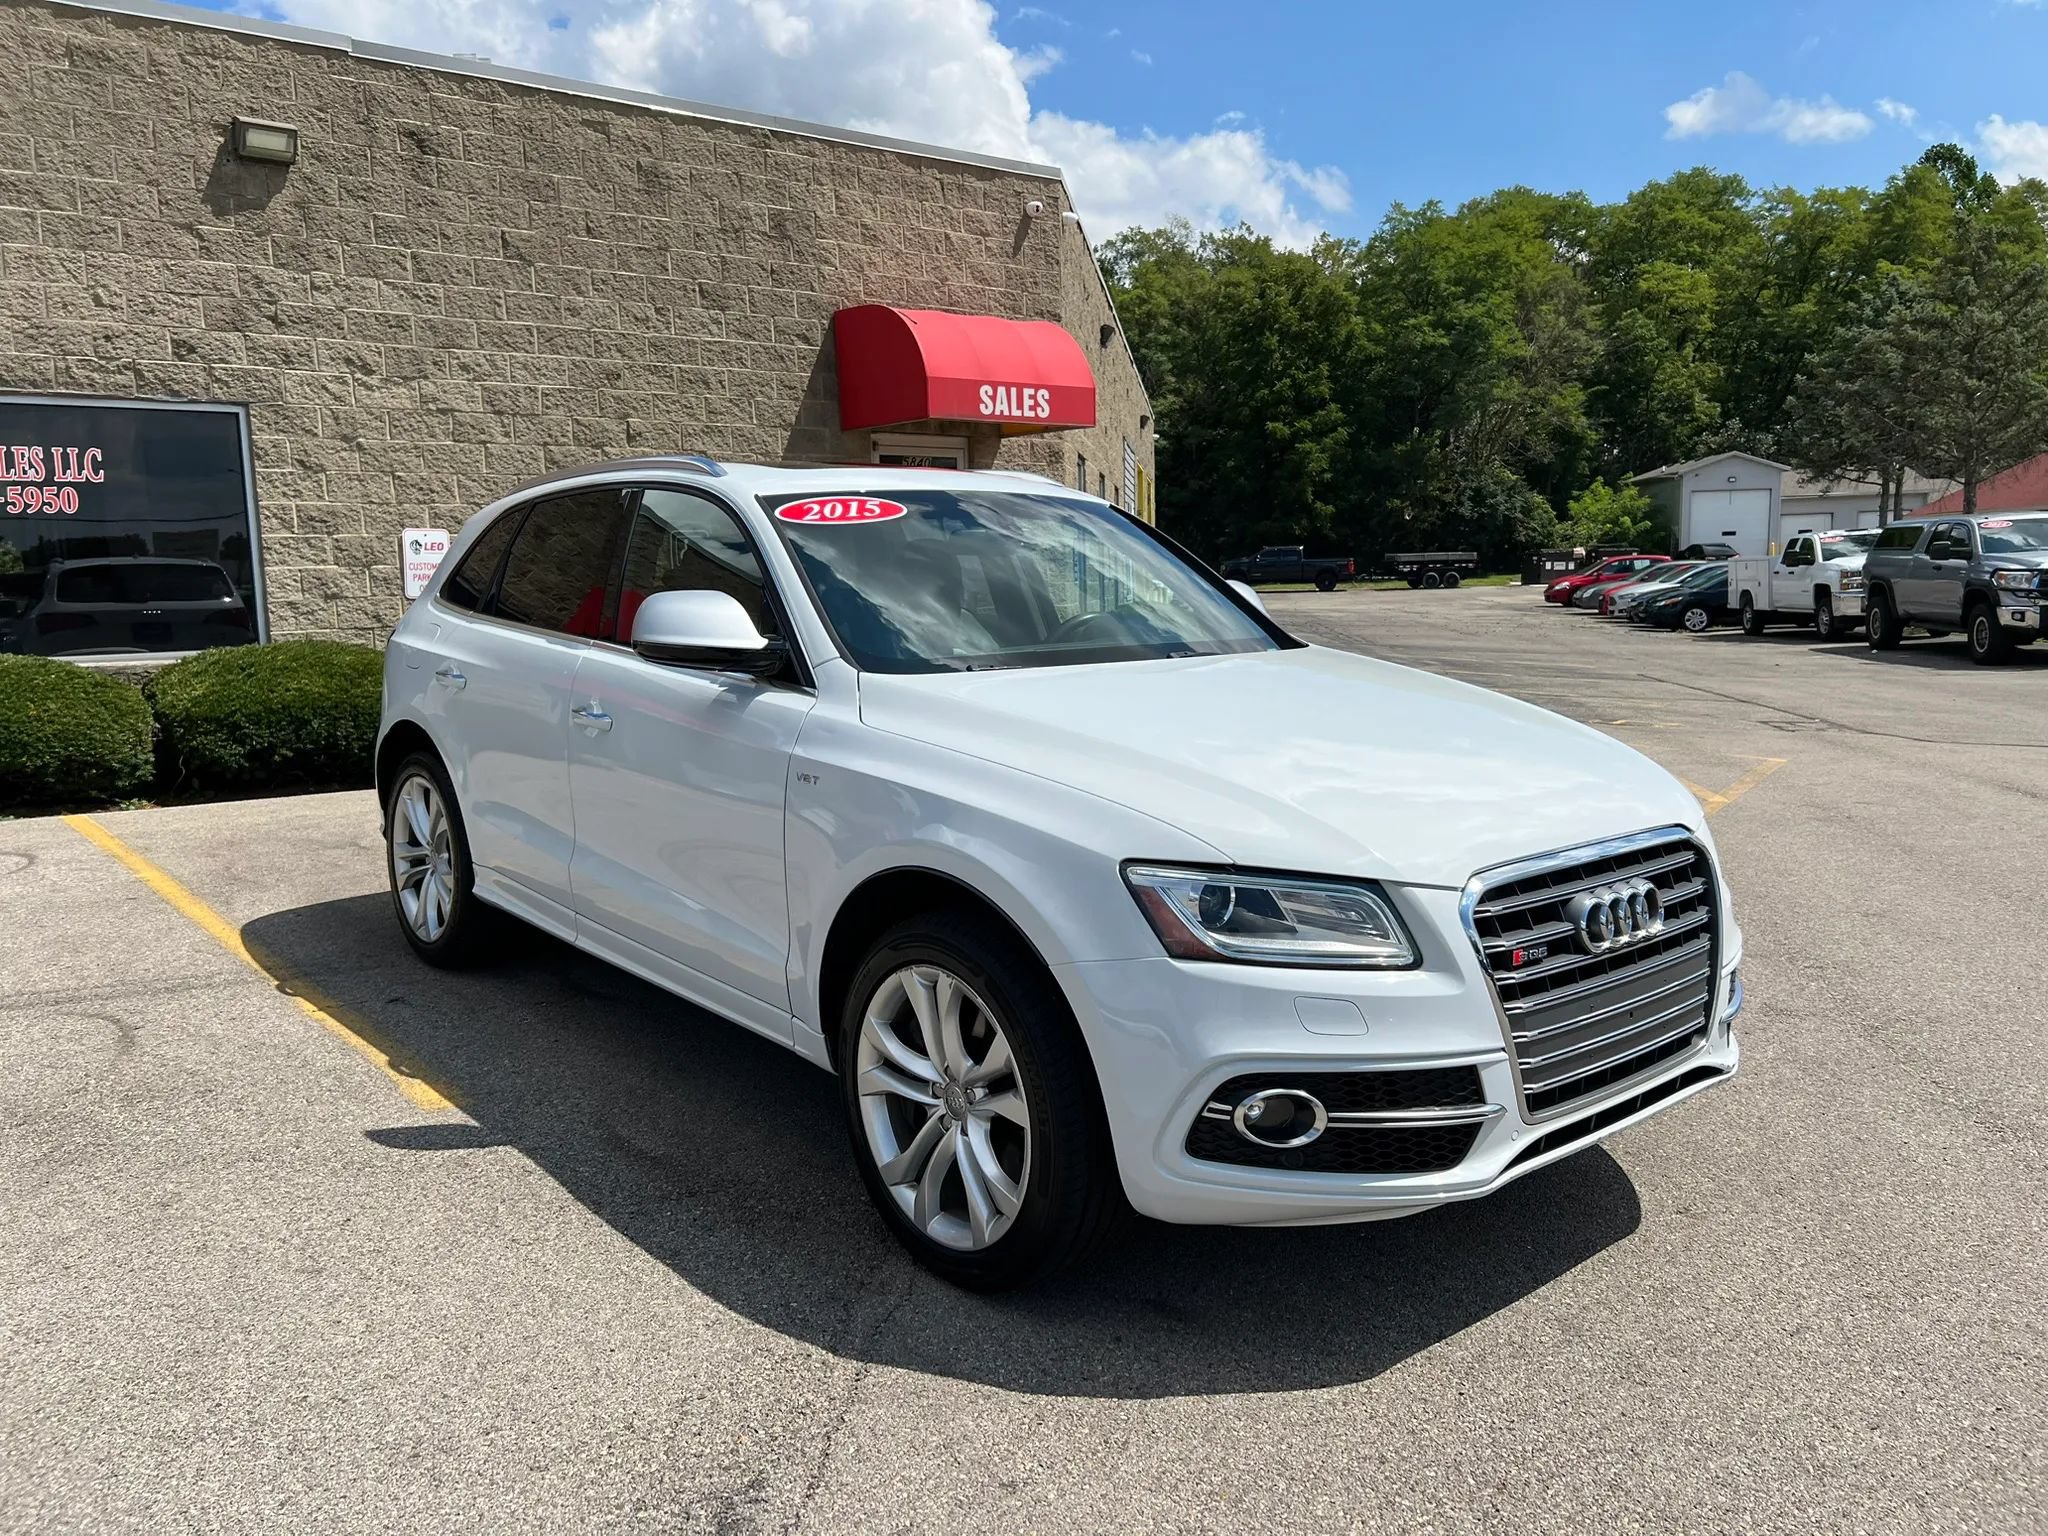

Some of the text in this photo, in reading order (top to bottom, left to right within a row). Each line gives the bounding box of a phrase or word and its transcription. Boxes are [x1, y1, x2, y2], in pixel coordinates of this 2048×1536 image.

[979, 384, 1051, 419] SALES
[51, 447, 105, 483] LLC
[802, 501, 881, 520] 2015
[424, 542, 444, 551] LEO
